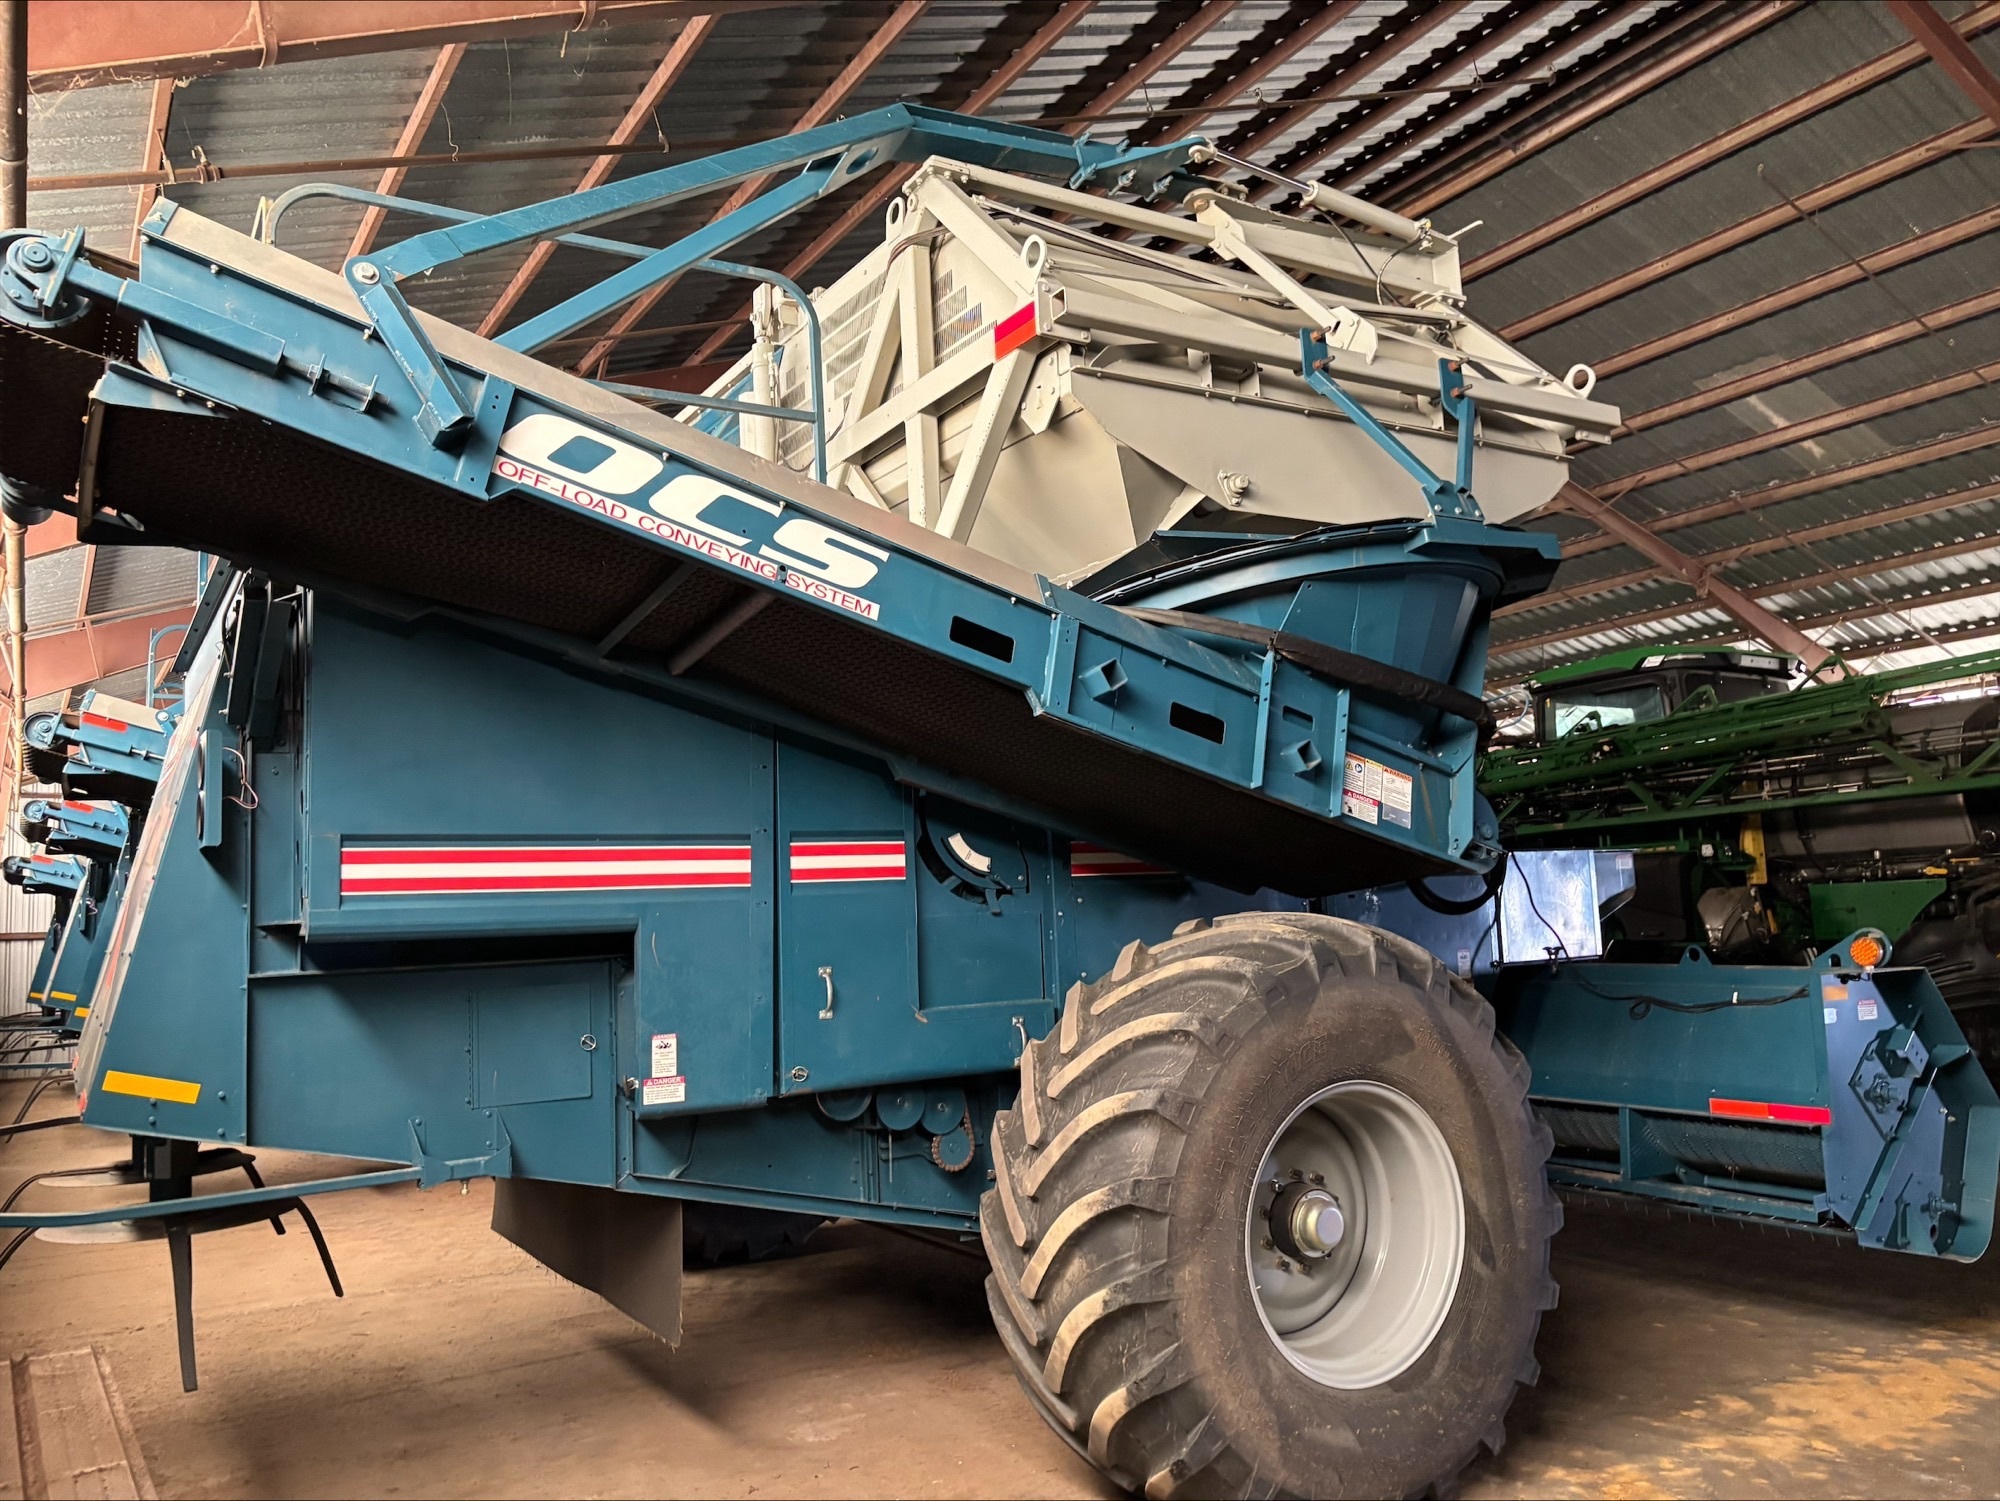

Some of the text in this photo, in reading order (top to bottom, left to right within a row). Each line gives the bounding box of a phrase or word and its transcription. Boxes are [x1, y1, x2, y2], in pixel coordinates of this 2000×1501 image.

[497, 460, 872, 616] OFF-LOAD CONVEYING SYSTEM
[498, 413, 890, 588] OCS
[1353, 793, 1375, 805] DANGER
[653, 1077, 681, 1085] DANGER
